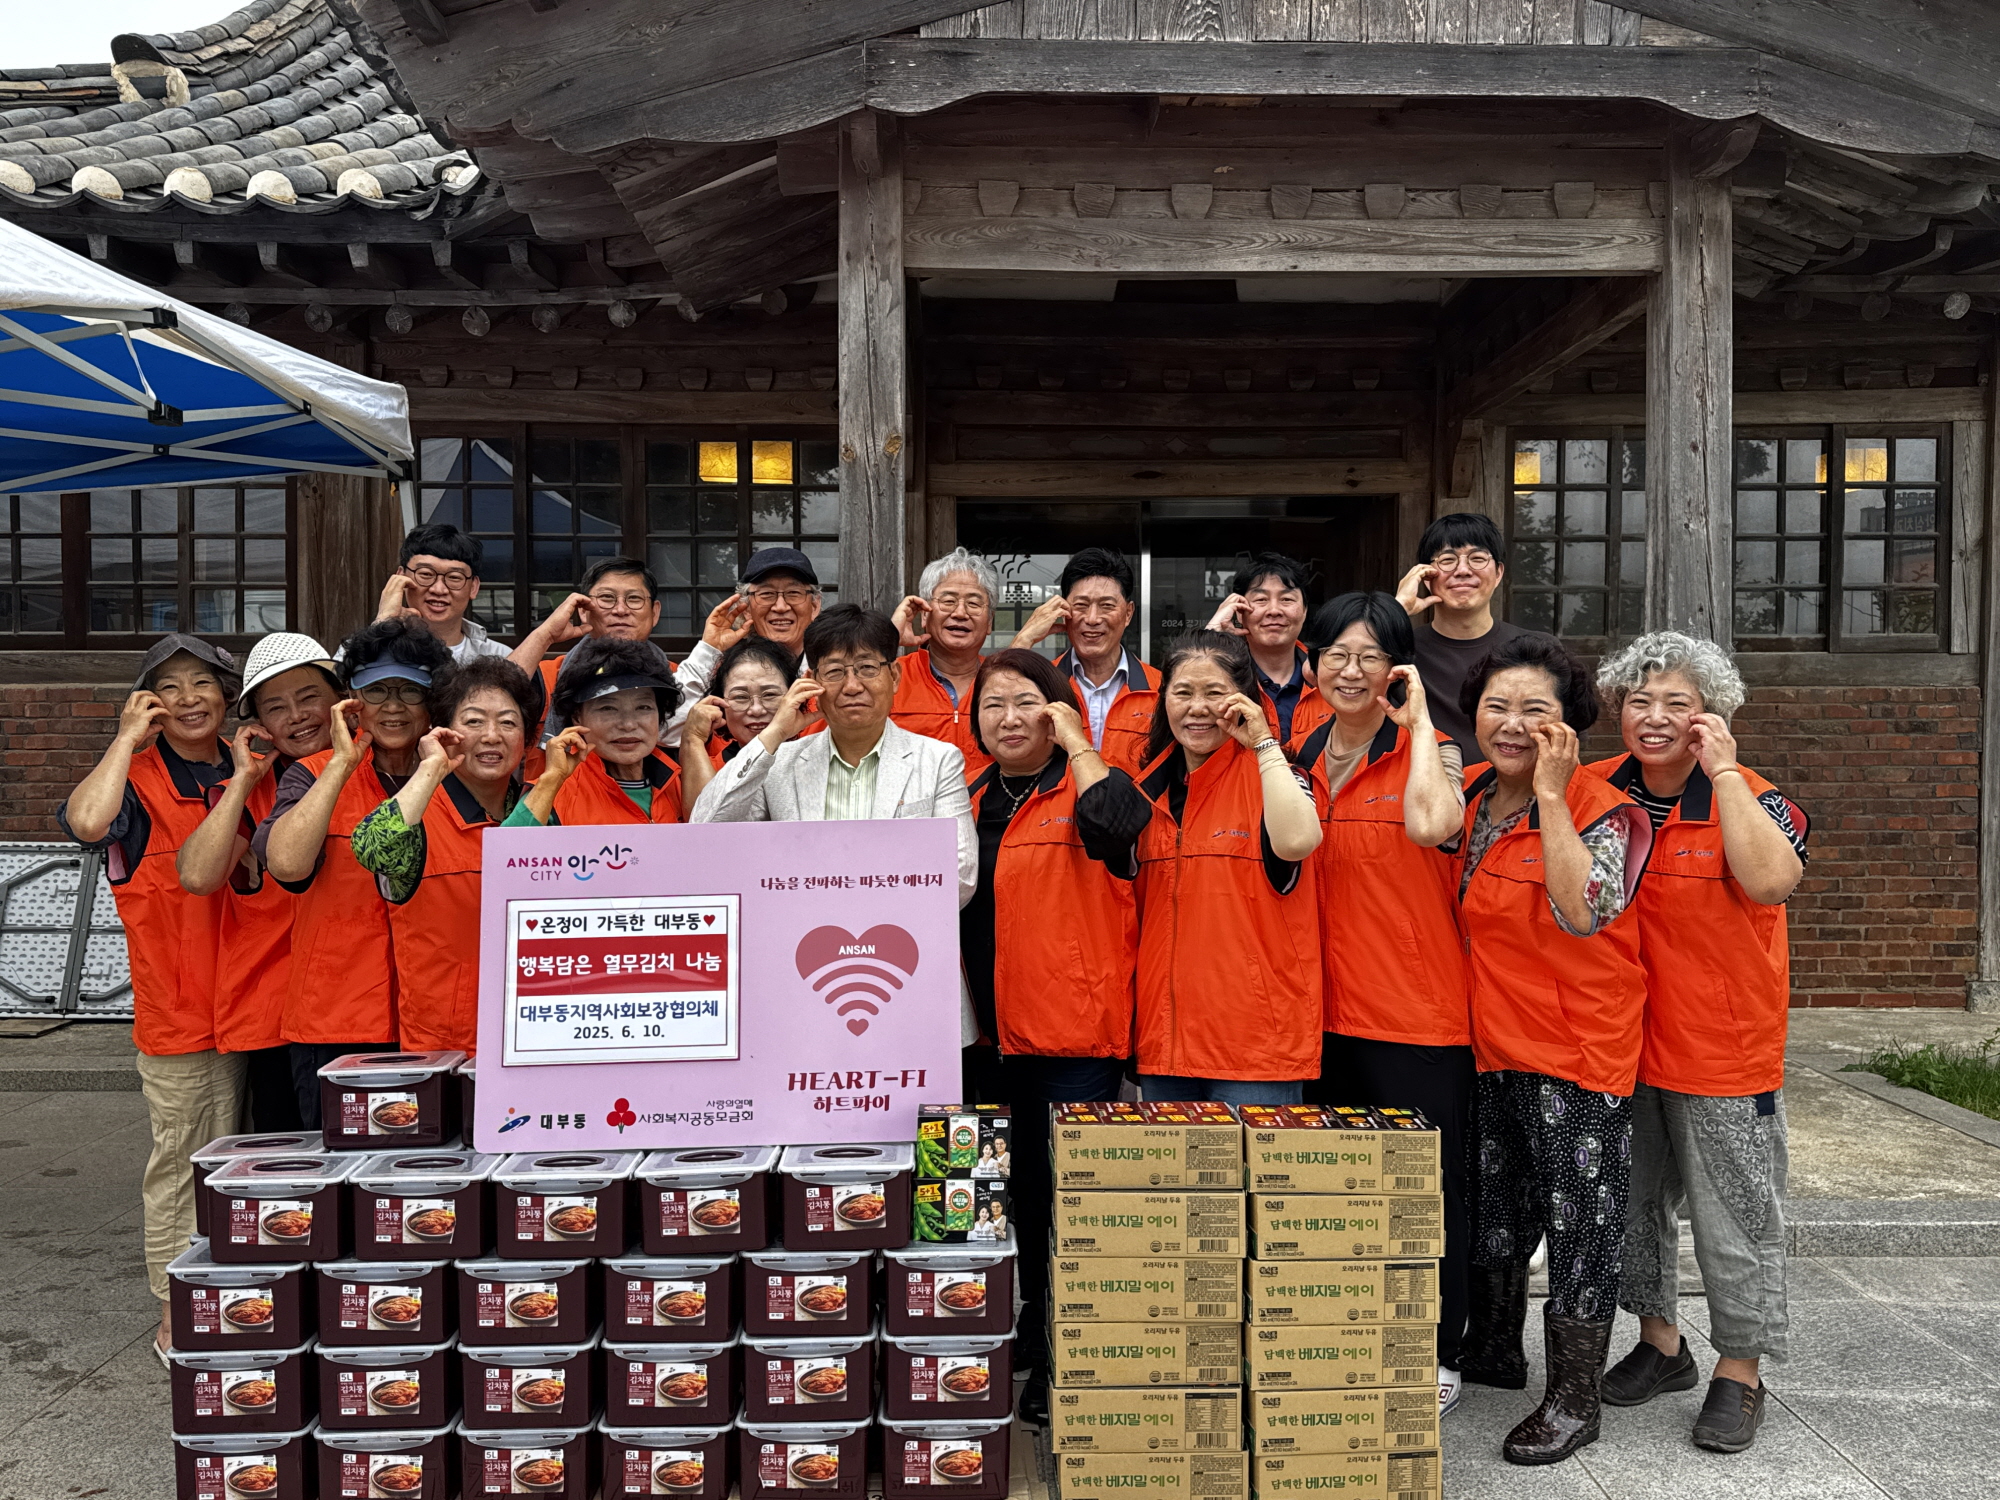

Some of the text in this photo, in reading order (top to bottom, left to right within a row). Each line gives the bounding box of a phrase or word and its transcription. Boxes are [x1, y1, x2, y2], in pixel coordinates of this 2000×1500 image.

[507, 857, 562, 868] ANSAN
[531, 871, 561, 881] CITY
[761, 874, 942, 890] 나눔을 전파하는 따듯한 에너지
[541, 913, 701, 934] 온정이 가득한 대부동
[838, 945, 875, 955] ANSAN
[518, 952, 722, 976] 행복담은 열무김치 나눔
[520, 1000, 718, 1023] 대부동지역사회보장협의체
[574, 1025, 665, 1039] 2025. 6. 10.
[788, 1069, 927, 1091] HEART-FI
[344, 1094, 354, 1102] 5L
[706, 1099, 753, 1110] 사랑의열매
[813, 1095, 890, 1113] 하트파이
[541, 1114, 586, 1130] 대부동
[638, 1111, 753, 1126] 사회복지공동모금회
[924, 1124, 940, 1133] 5+1
[1069, 1148, 1176, 1160] 담백한 베지밀 에이
[1262, 1152, 1371, 1165] 담백한 베지밀 에이
[807, 1188, 819, 1197] 5L
[920, 1187, 936, 1195] 5+1
[518, 1198, 530, 1206] 5L
[662, 1193, 674, 1201] 5L
[1068, 1215, 1176, 1227] 담백한 베지밀 에이
[1271, 1219, 1378, 1231] 담백한 베지밀 에이
[769, 1277, 782, 1285] 5L
[910, 1274, 921, 1282] 5L
[344, 1285, 354, 1293] 5L
[480, 1284, 491, 1292] 5L
[629, 1282, 640, 1290] 5L
[1066, 1280, 1174, 1292] 담백한 베지밀 에이
[1266, 1285, 1374, 1297] 담백한 베지밀 에이
[193, 1290, 205, 1298] 5L
[1068, 1346, 1175, 1358] 담백한 베지밀 에이
[1264, 1348, 1372, 1360] 담백한 베지밀 에이
[769, 1361, 780, 1370] 5L
[913, 1358, 924, 1366] 5L
[631, 1363, 642, 1372] 5L
[196, 1374, 207, 1382] 5L
[340, 1373, 352, 1381] 5L
[487, 1370, 499, 1378] 5L
[1065, 1414, 1173, 1426] 담백한 베지밀 에이
[1267, 1413, 1374, 1427] 담백한 베지밀 에이
[763, 1445, 774, 1453] 5L
[344, 1455, 355, 1463] 5L
[486, 1451, 498, 1459] 5L
[627, 1451, 638, 1459] 5L
[198, 1459, 209, 1467] 5L
[1072, 1475, 1180, 1487] 담백한 베지밀 에이
[1272, 1474, 1377, 1490] 담백한 베지밀 에이
